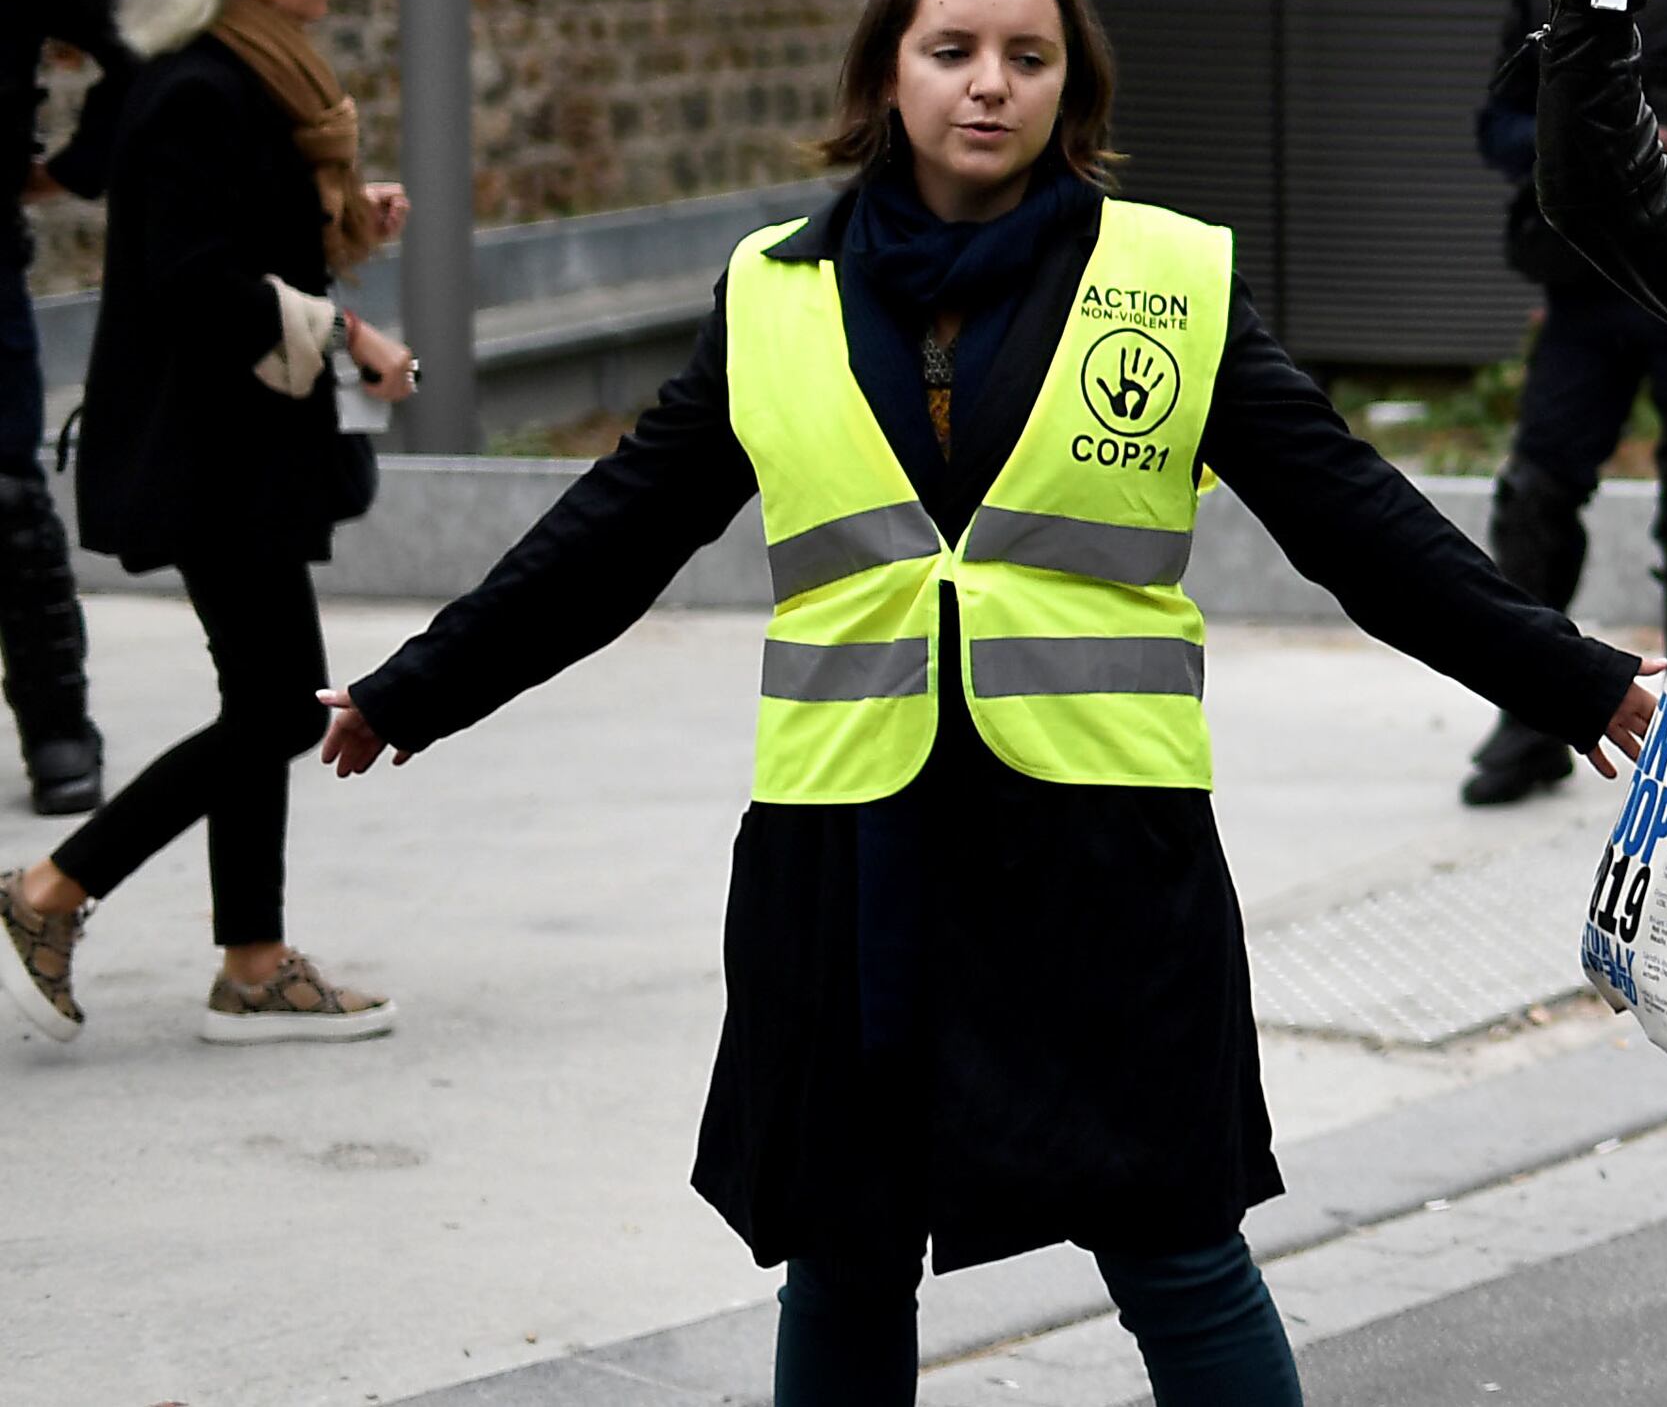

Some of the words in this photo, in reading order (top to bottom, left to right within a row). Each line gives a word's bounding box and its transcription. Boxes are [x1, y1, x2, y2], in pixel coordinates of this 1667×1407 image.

[1083, 285, 1188, 317] ACTION
[1081, 305, 1187, 331] NON-VIOLENTE
[1071, 434, 1169, 472] COP21
